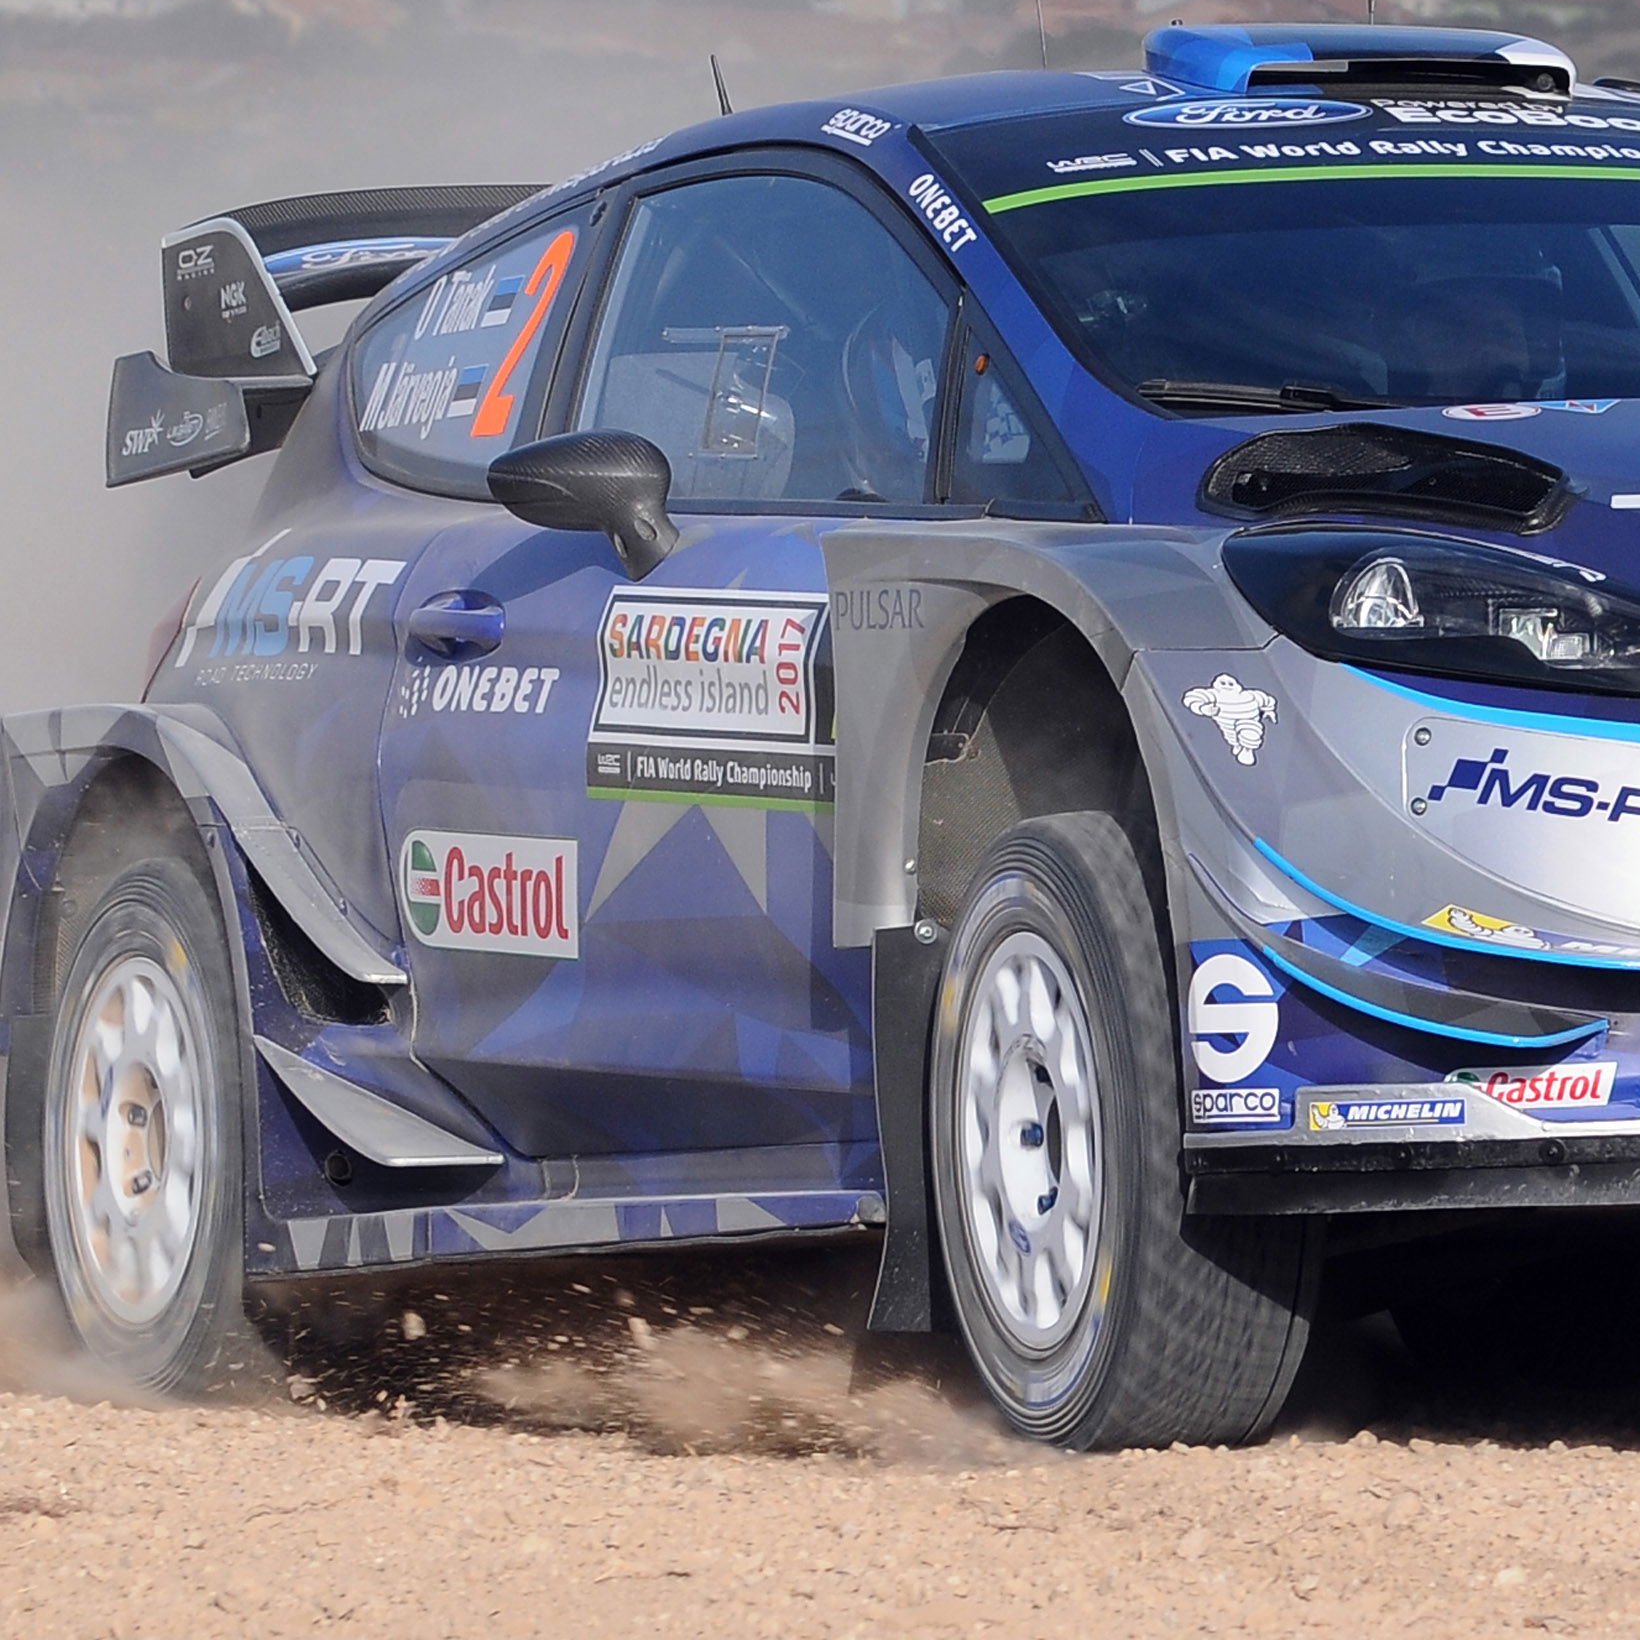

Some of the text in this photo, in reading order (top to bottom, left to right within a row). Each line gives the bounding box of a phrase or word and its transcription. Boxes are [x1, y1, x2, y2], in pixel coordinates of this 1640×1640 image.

[828, 108, 892, 140] sparco
[1176, 101, 1327, 124] Ford
[1164, 147, 1238, 163] FIA
[1239, 141, 1359, 160] World
[1369, 140, 1468, 157] Rally
[908, 173, 977, 253] ONEBET
[470, 231, 574, 437] 2
[835, 588, 925, 631] PULSAR
[609, 614, 769, 664] SARDEGNA
[776, 617, 808, 715] 2017
[432, 665, 560, 714] ONEBET
[609, 665, 769, 715] endless island
[636, 756, 656, 778] FIA
[657, 757, 691, 781] World
[694, 758, 724, 787] Rally
[726, 761, 812, 793] Championship
[444, 846, 569, 940] Castrol
[1194, 1091, 1276, 1118] sparco
[1485, 1068, 1602, 1103] Castrol
[1347, 1102, 1463, 1120] MICHELIN
